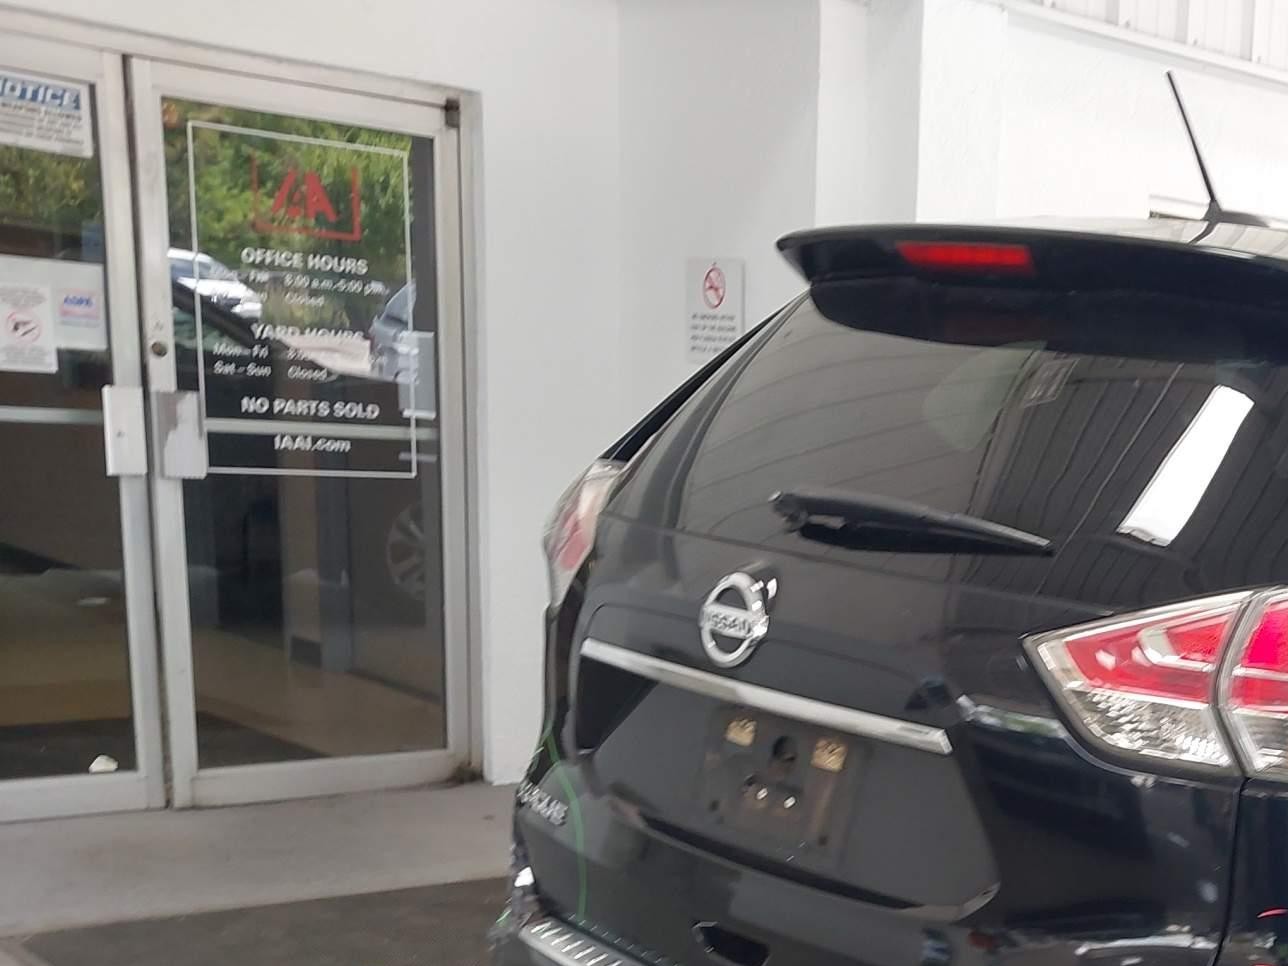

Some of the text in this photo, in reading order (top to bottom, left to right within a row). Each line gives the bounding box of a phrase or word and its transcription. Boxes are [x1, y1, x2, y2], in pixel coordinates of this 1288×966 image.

[0, 78, 81, 111] OTICE
[240, 247, 369, 275] OFFICE HOURS
[251, 322, 300, 341] YARD
[214, 360, 236, 375] Sat
[246, 363, 272, 377] Sun
[287, 365, 328, 380] Closed
[240, 396, 380, 419] NO PARTS SOLD
[273, 434, 351, 452] IAAI.com
